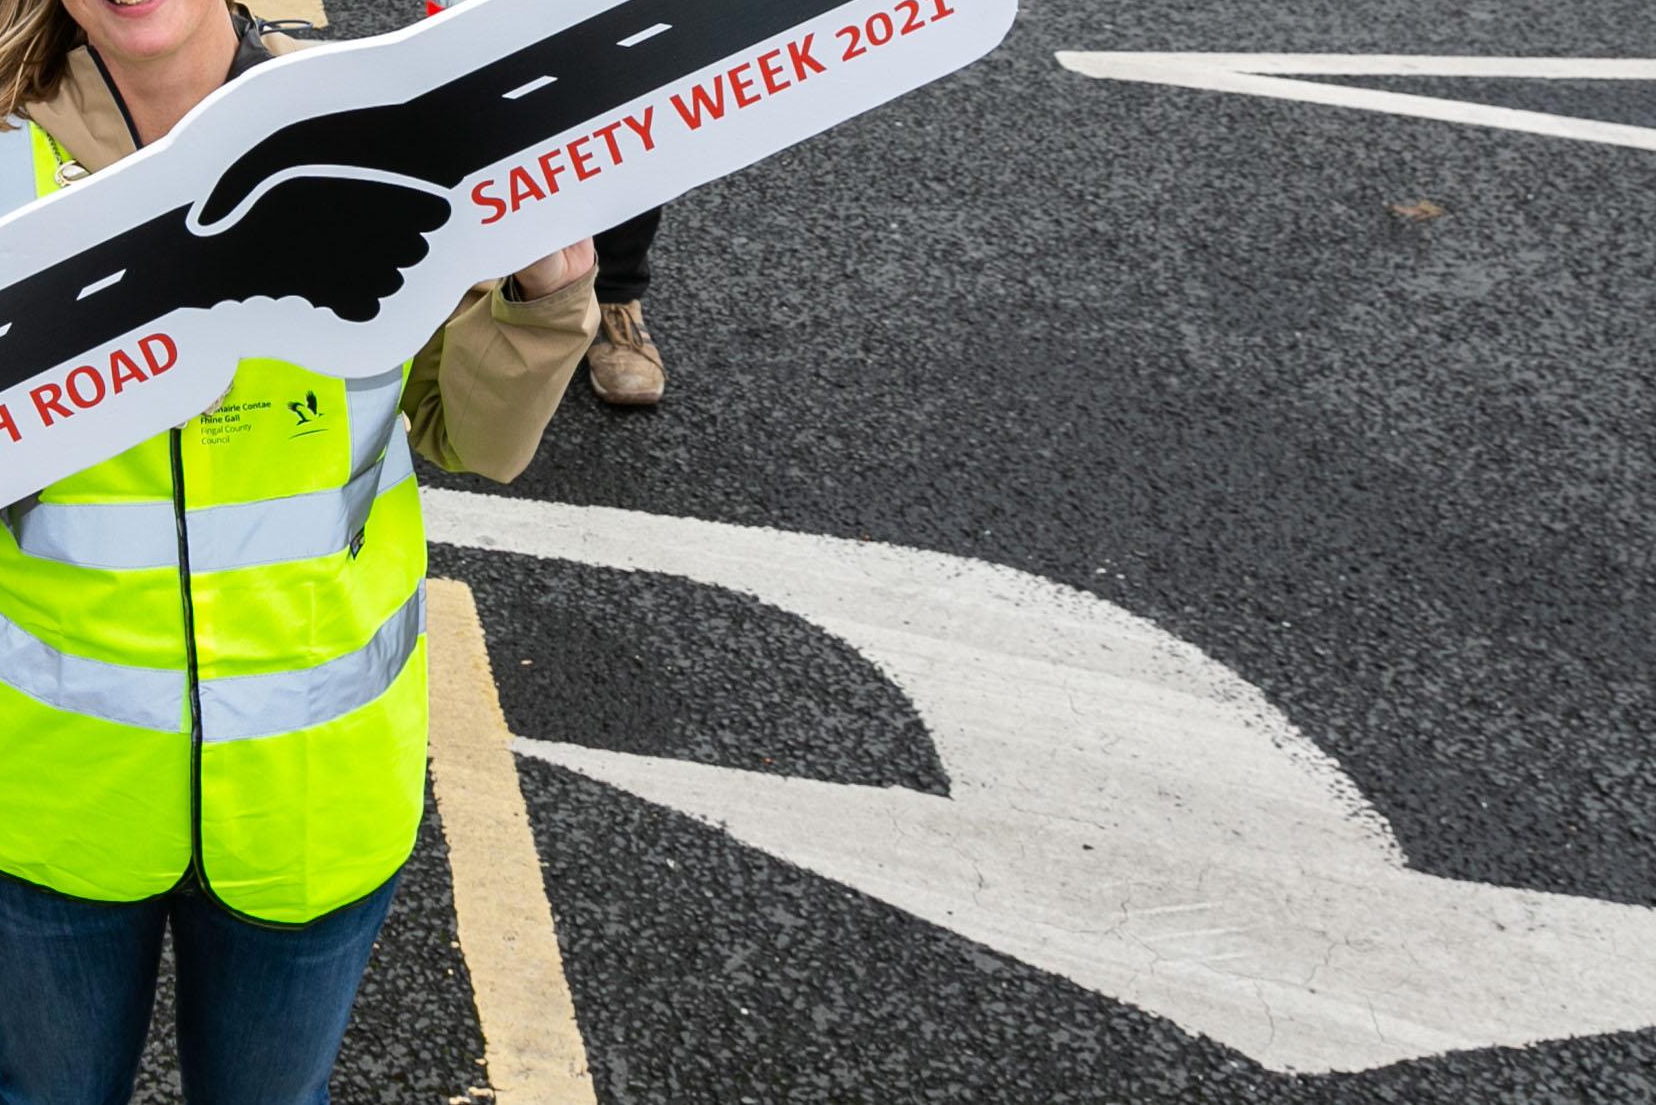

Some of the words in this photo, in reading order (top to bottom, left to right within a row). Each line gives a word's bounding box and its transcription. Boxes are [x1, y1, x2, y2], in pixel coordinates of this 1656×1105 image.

[471, 106, 655, 225] SAFETY
[669, 32, 826, 131] WEEK
[29, 332, 179, 427] ROAD
[242, 401, 271, 411] Contae
[224, 414, 240, 424] Gall
[200, 426, 223, 437] Fingal
[225, 422, 252, 434] County
[201, 435, 230, 446] Council
